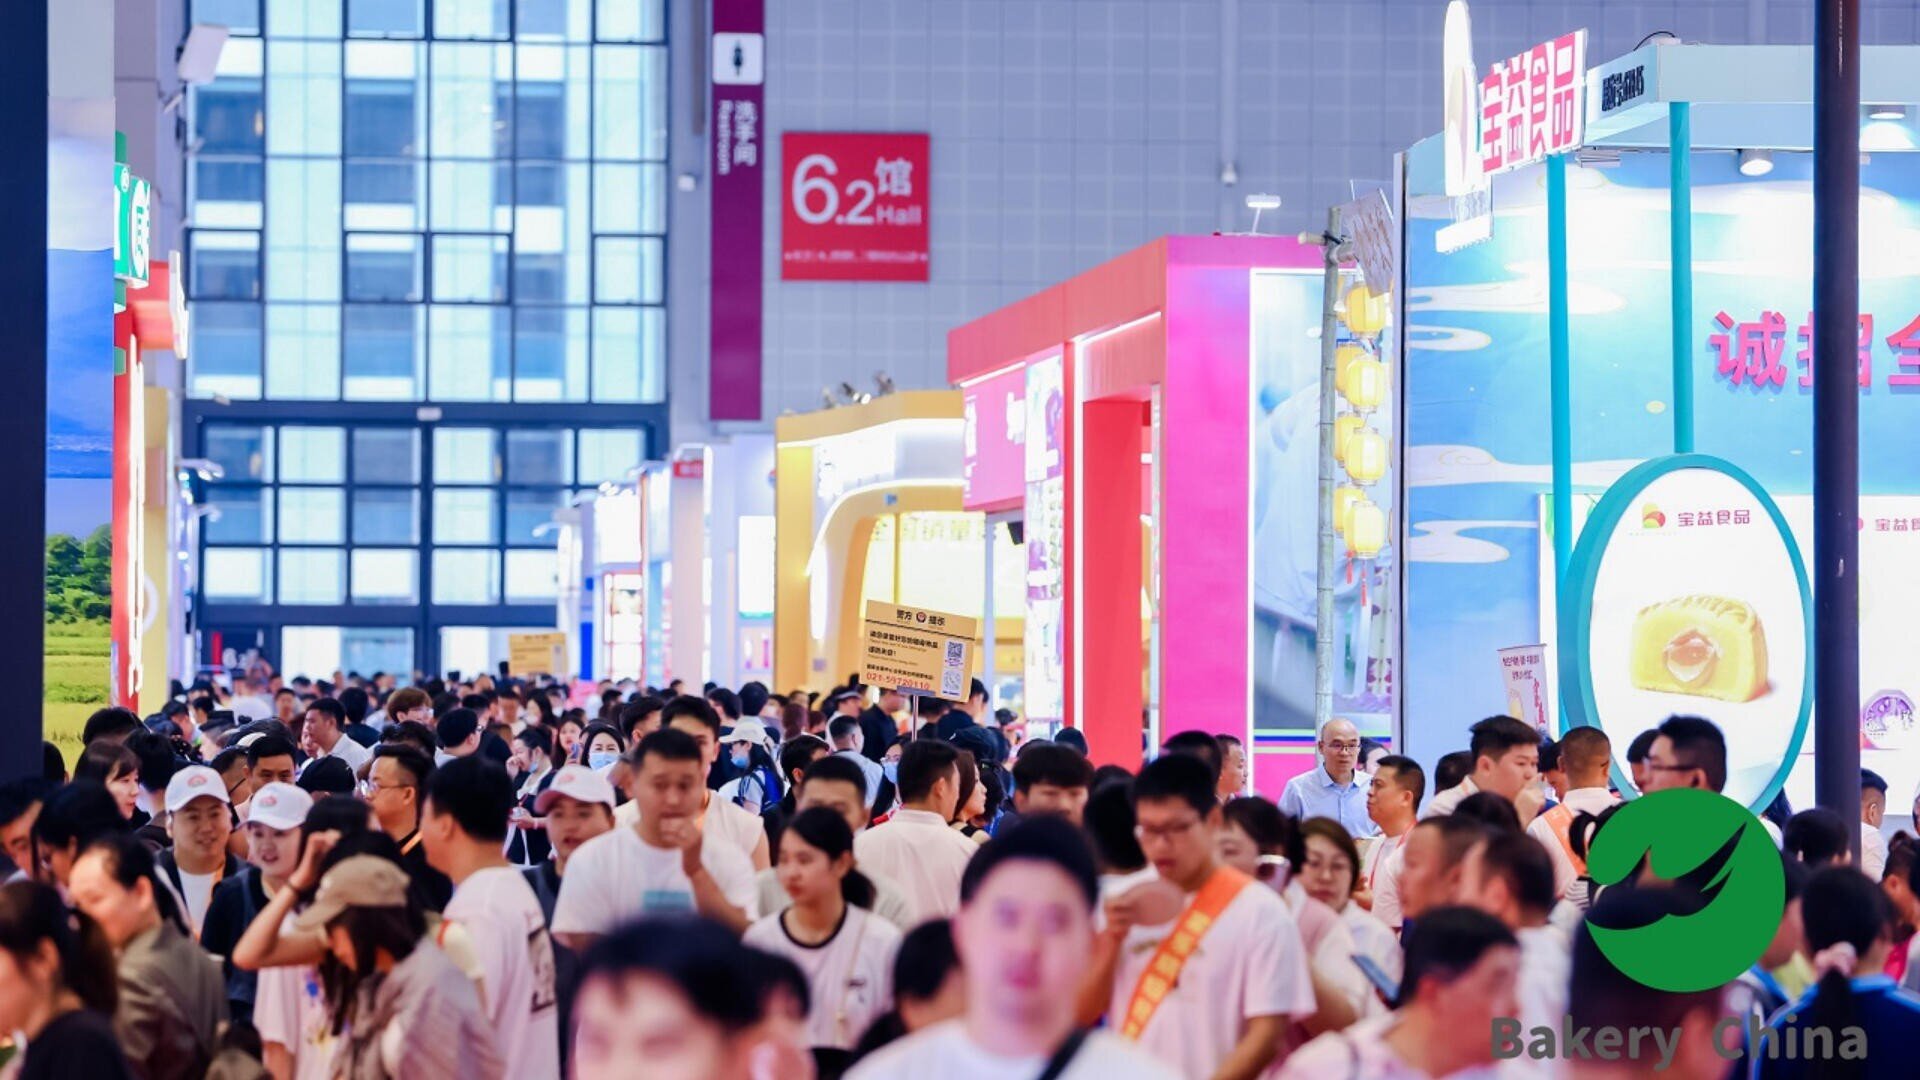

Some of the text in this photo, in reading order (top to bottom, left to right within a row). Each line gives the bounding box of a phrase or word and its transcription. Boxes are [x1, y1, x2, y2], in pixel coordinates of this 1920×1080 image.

[1483, 32, 1575, 173] 宝益食品
[792, 153, 912, 225] 6.2 馆
[876, 205, 921, 225] Hall
[1678, 509, 1750, 527] 宝益食品
